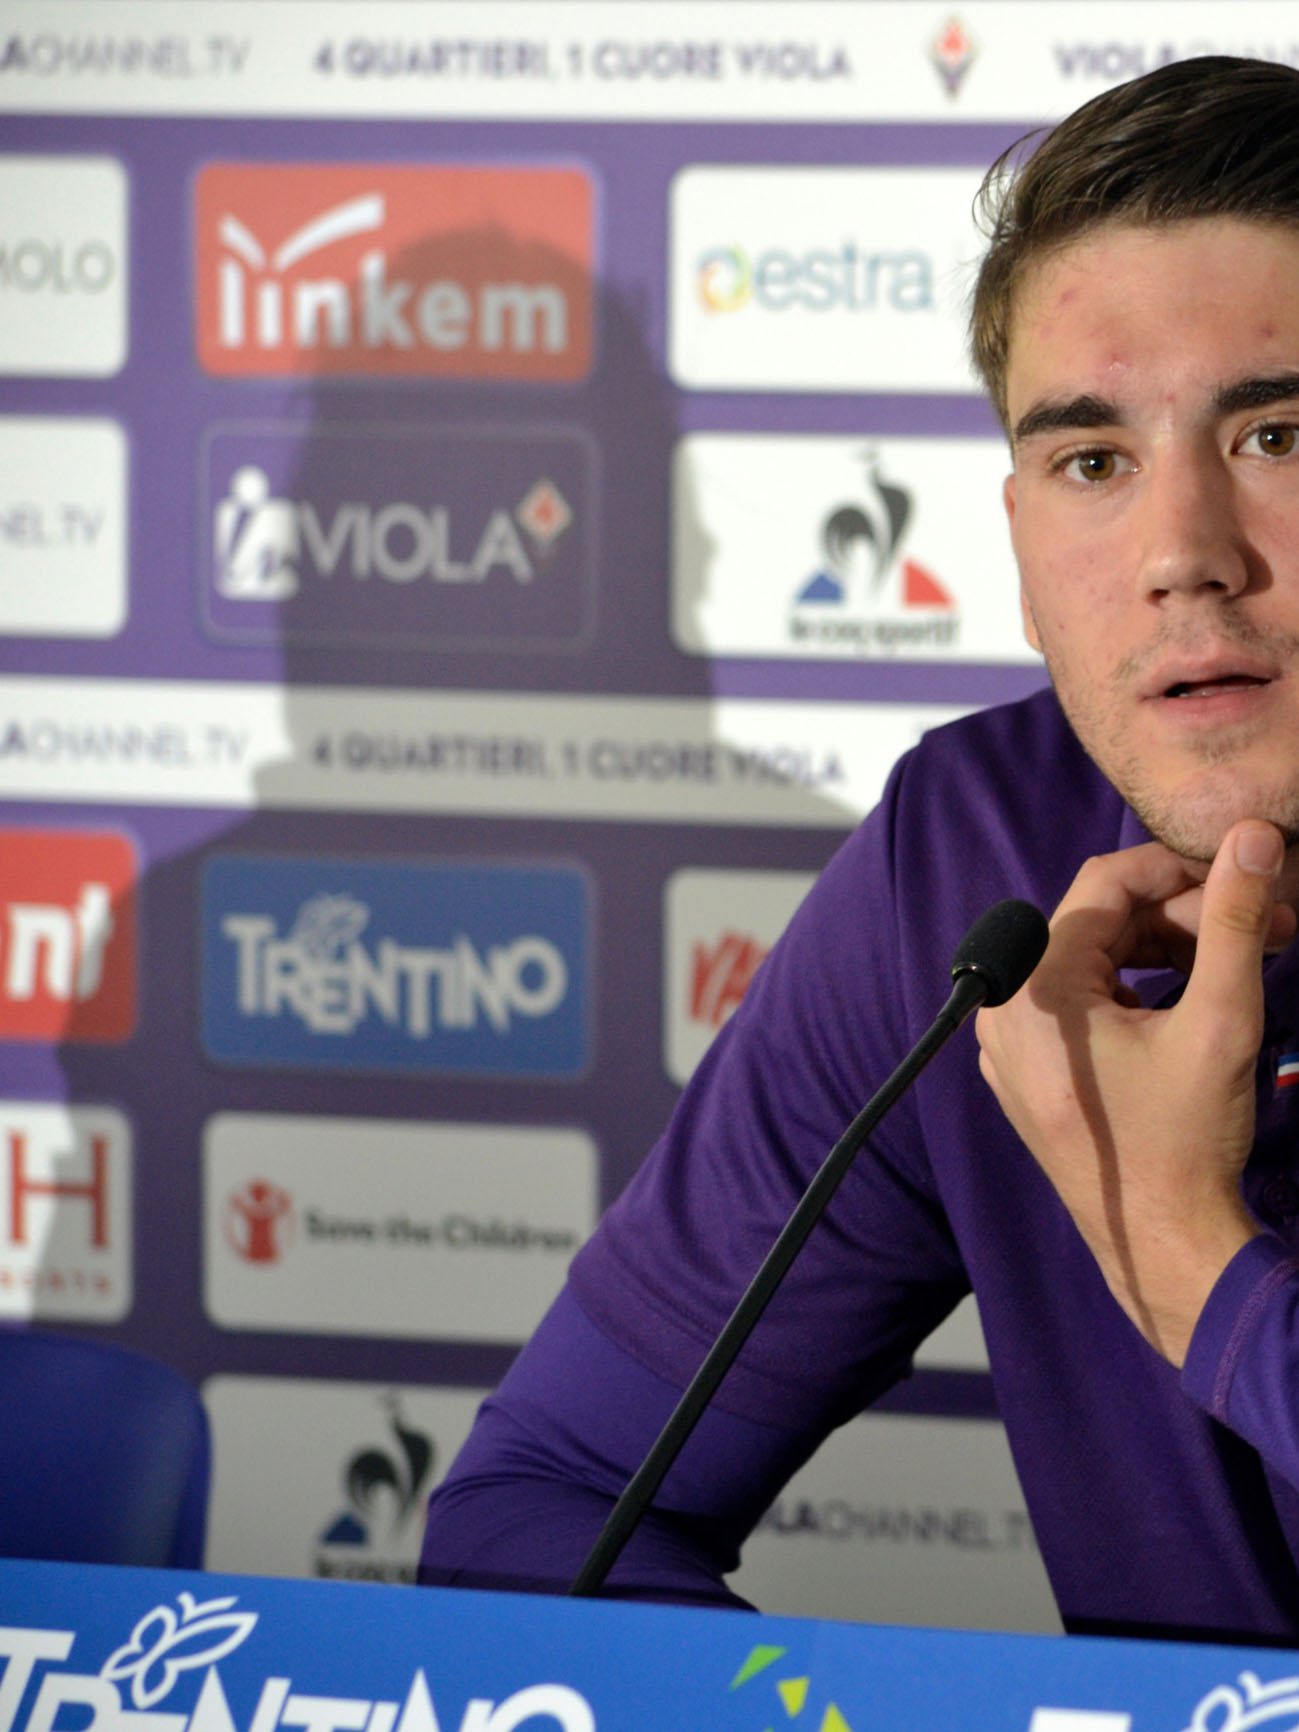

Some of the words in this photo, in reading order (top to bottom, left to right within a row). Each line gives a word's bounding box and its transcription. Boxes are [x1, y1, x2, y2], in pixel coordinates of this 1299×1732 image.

[313, 39, 335, 75] 4
[594, 39, 723, 79] CUORE
[733, 41, 853, 80] VIOLA
[218, 247, 569, 353] linkem
[755, 238, 934, 313] estra
[298, 502, 535, 586] VIOLA
[726, 744, 848, 787] VIOLA
[222, 912, 568, 1038] TRENTINO
